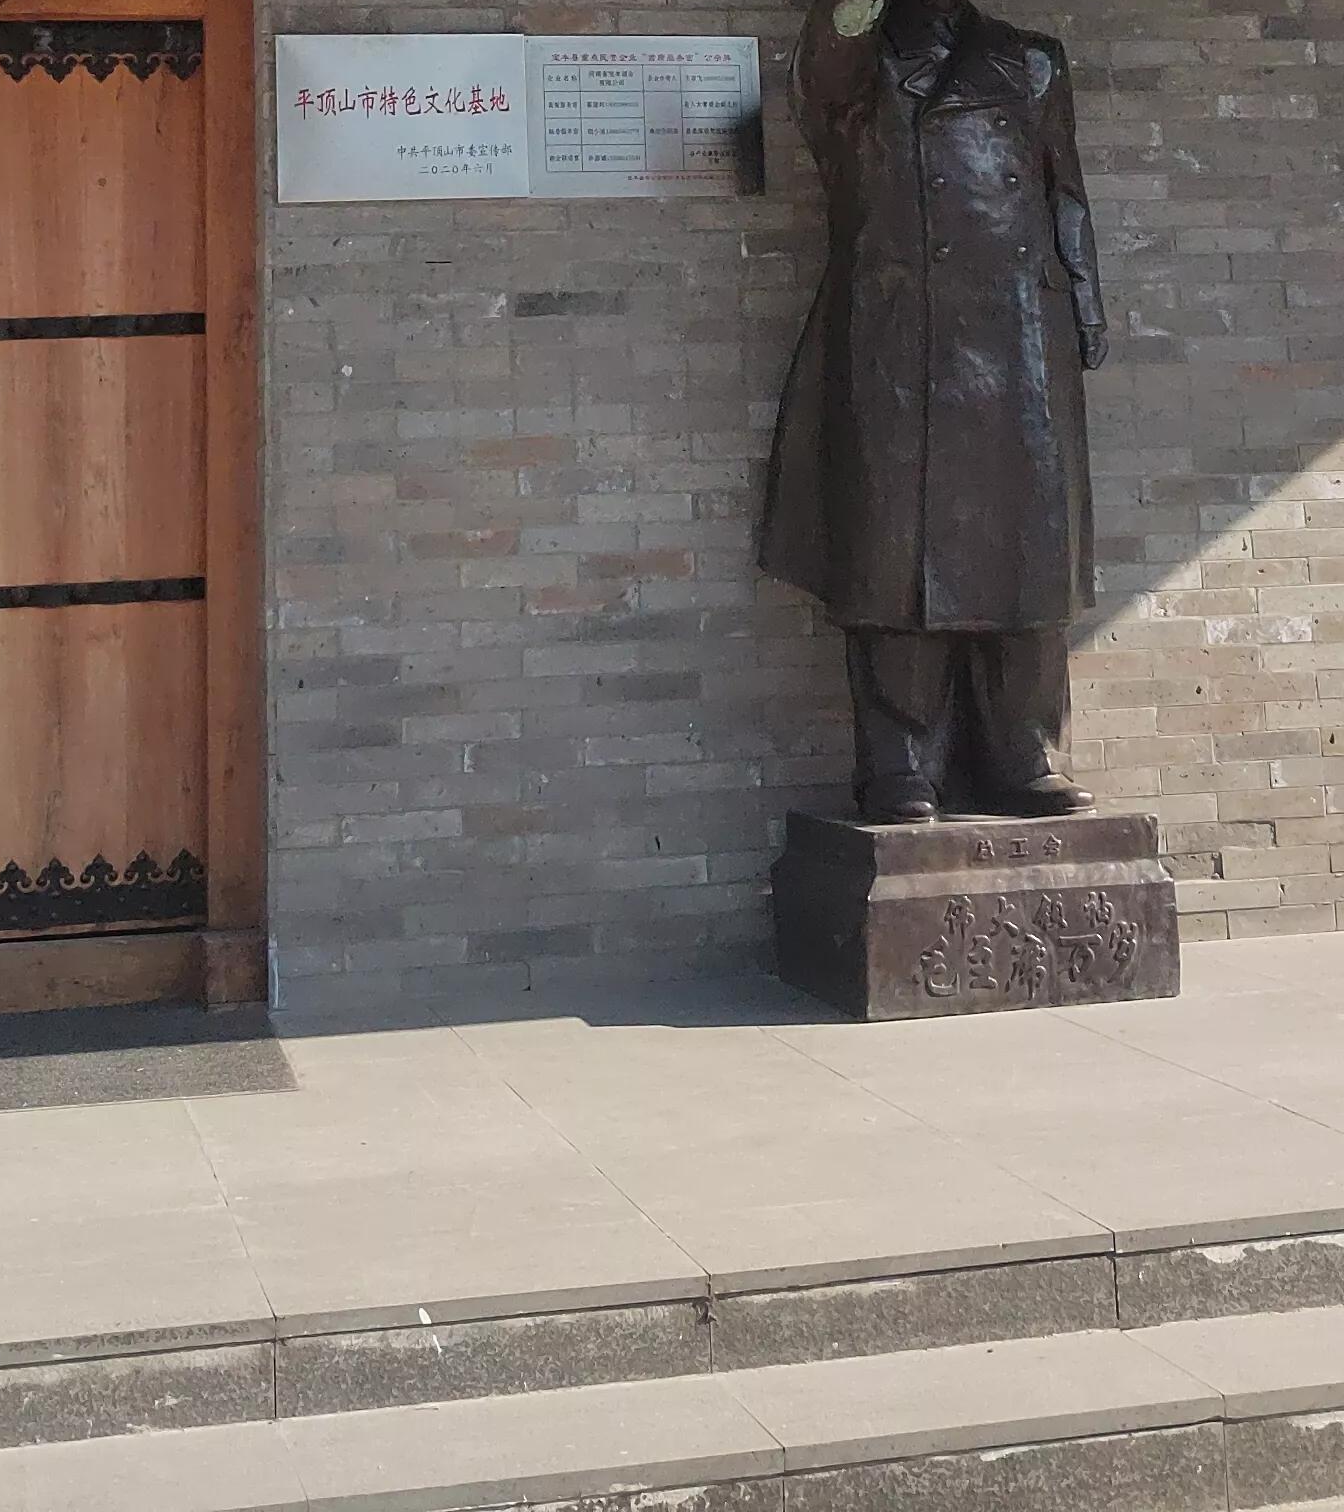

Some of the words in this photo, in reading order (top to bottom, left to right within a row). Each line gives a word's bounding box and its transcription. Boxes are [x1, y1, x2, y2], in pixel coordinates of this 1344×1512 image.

[294, 85, 510, 120] 平顶山市特色文化基地
[397, 143, 513, 160] 中共平顶山市委宣传部
